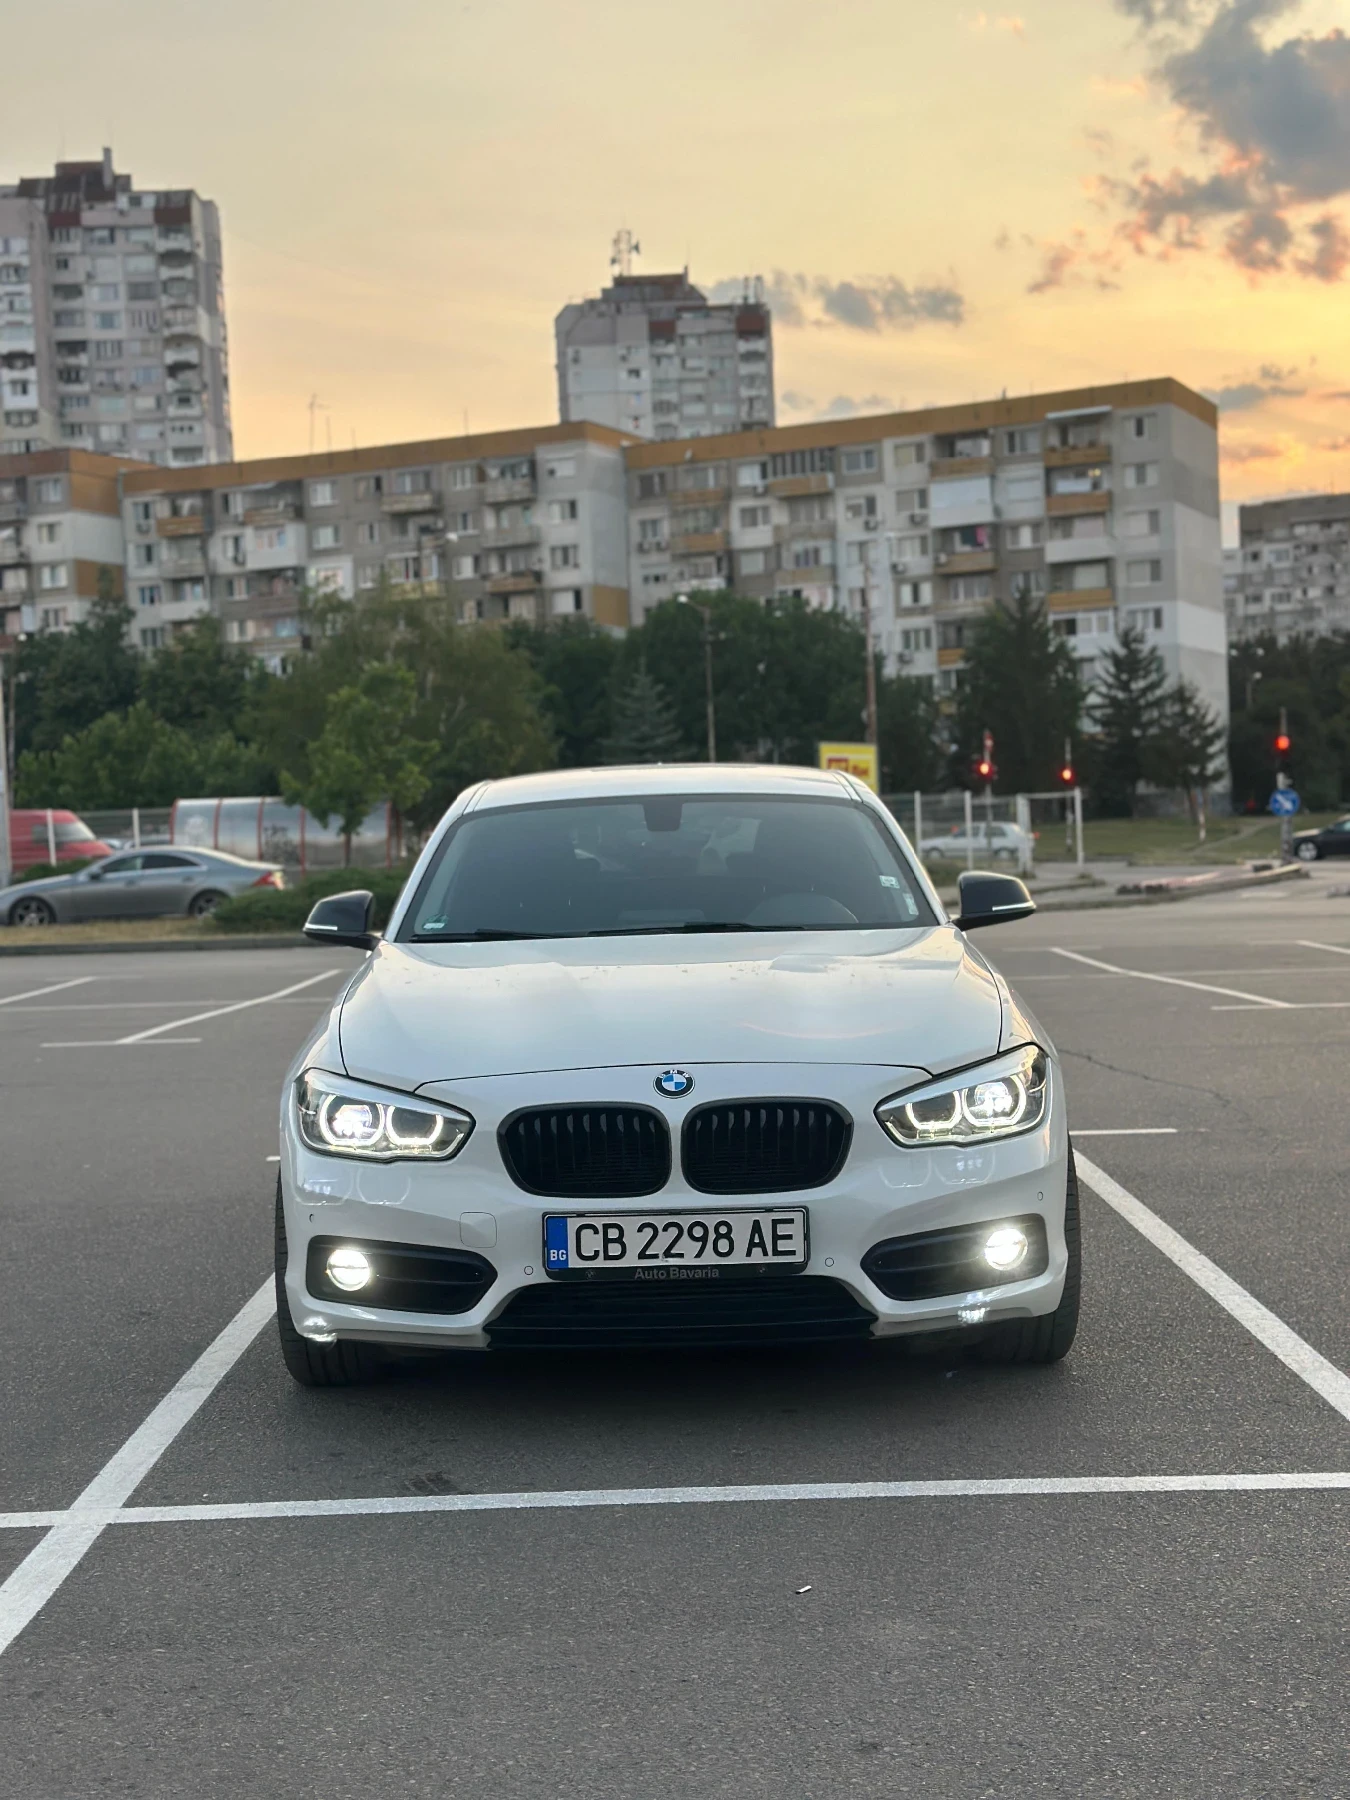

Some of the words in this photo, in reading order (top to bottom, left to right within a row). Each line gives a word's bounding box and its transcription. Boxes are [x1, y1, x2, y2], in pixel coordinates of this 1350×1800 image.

[575, 1222, 627, 1261] CB
[636, 1219, 735, 1260] 2298
[745, 1218, 797, 1257] AE
[550, 1249, 567, 1260] BG
[634, 1268, 667, 1280] Auto
[669, 1266, 720, 1279] Bavaria
